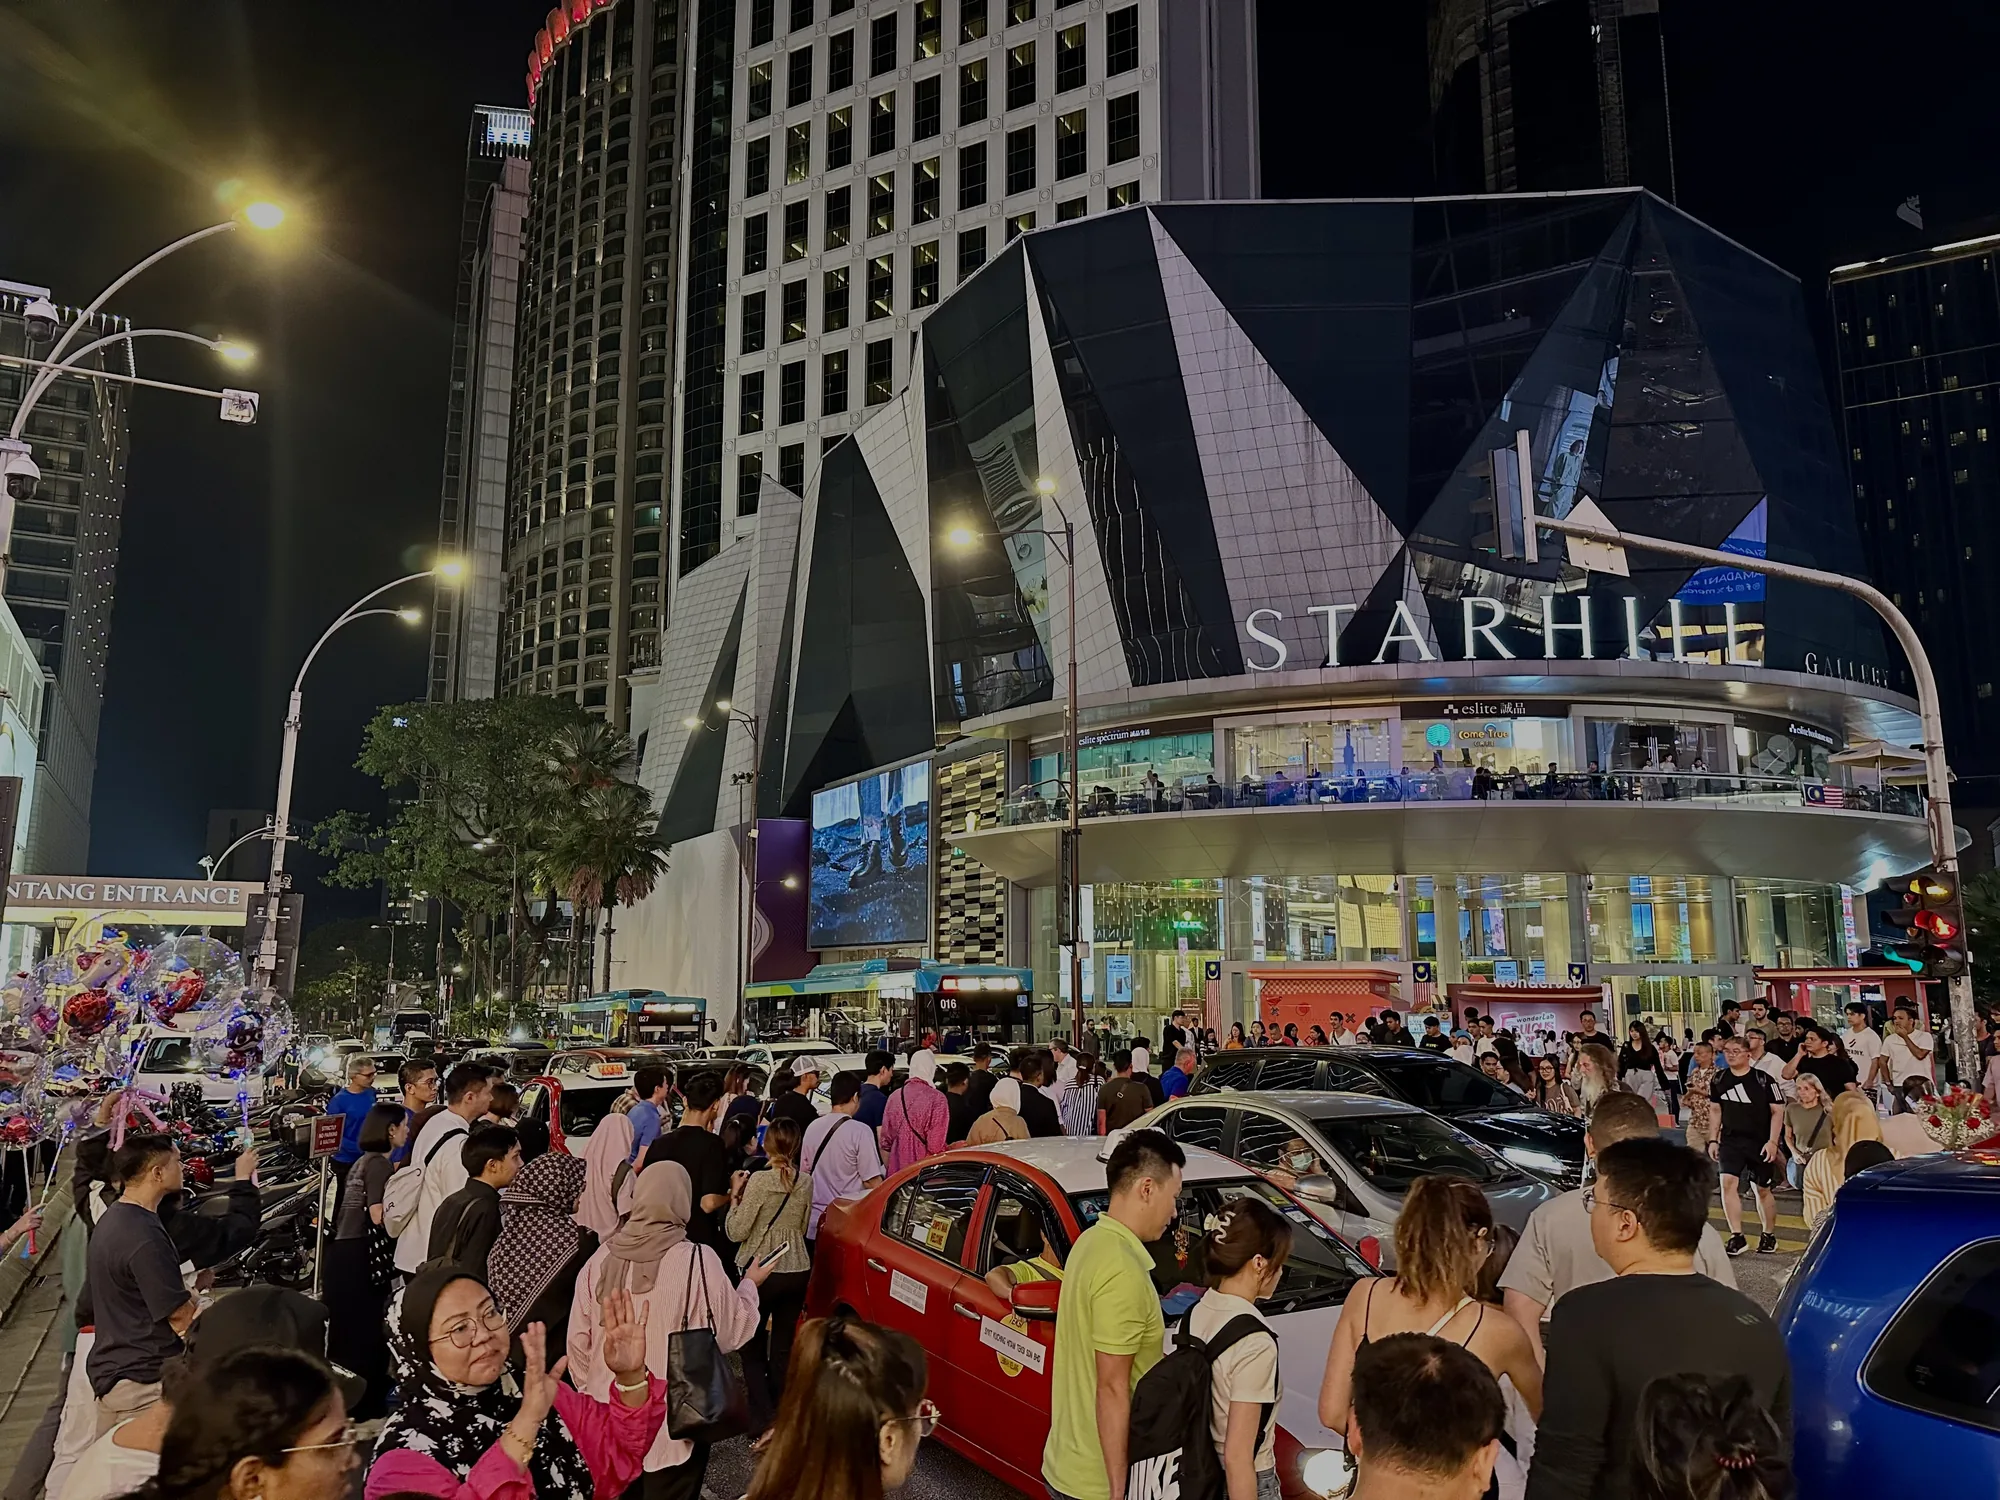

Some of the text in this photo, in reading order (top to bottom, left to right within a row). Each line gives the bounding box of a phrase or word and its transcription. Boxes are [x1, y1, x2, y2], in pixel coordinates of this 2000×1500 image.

[1246, 595, 1763, 671] STARHILL
[1461, 702, 1497, 714] eslite
[1488, 728, 1509, 739] True
[102, 884, 241, 905] ENTRANCE
[940, 999, 957, 1009] 016
[638, 1015, 650, 1023] 027
